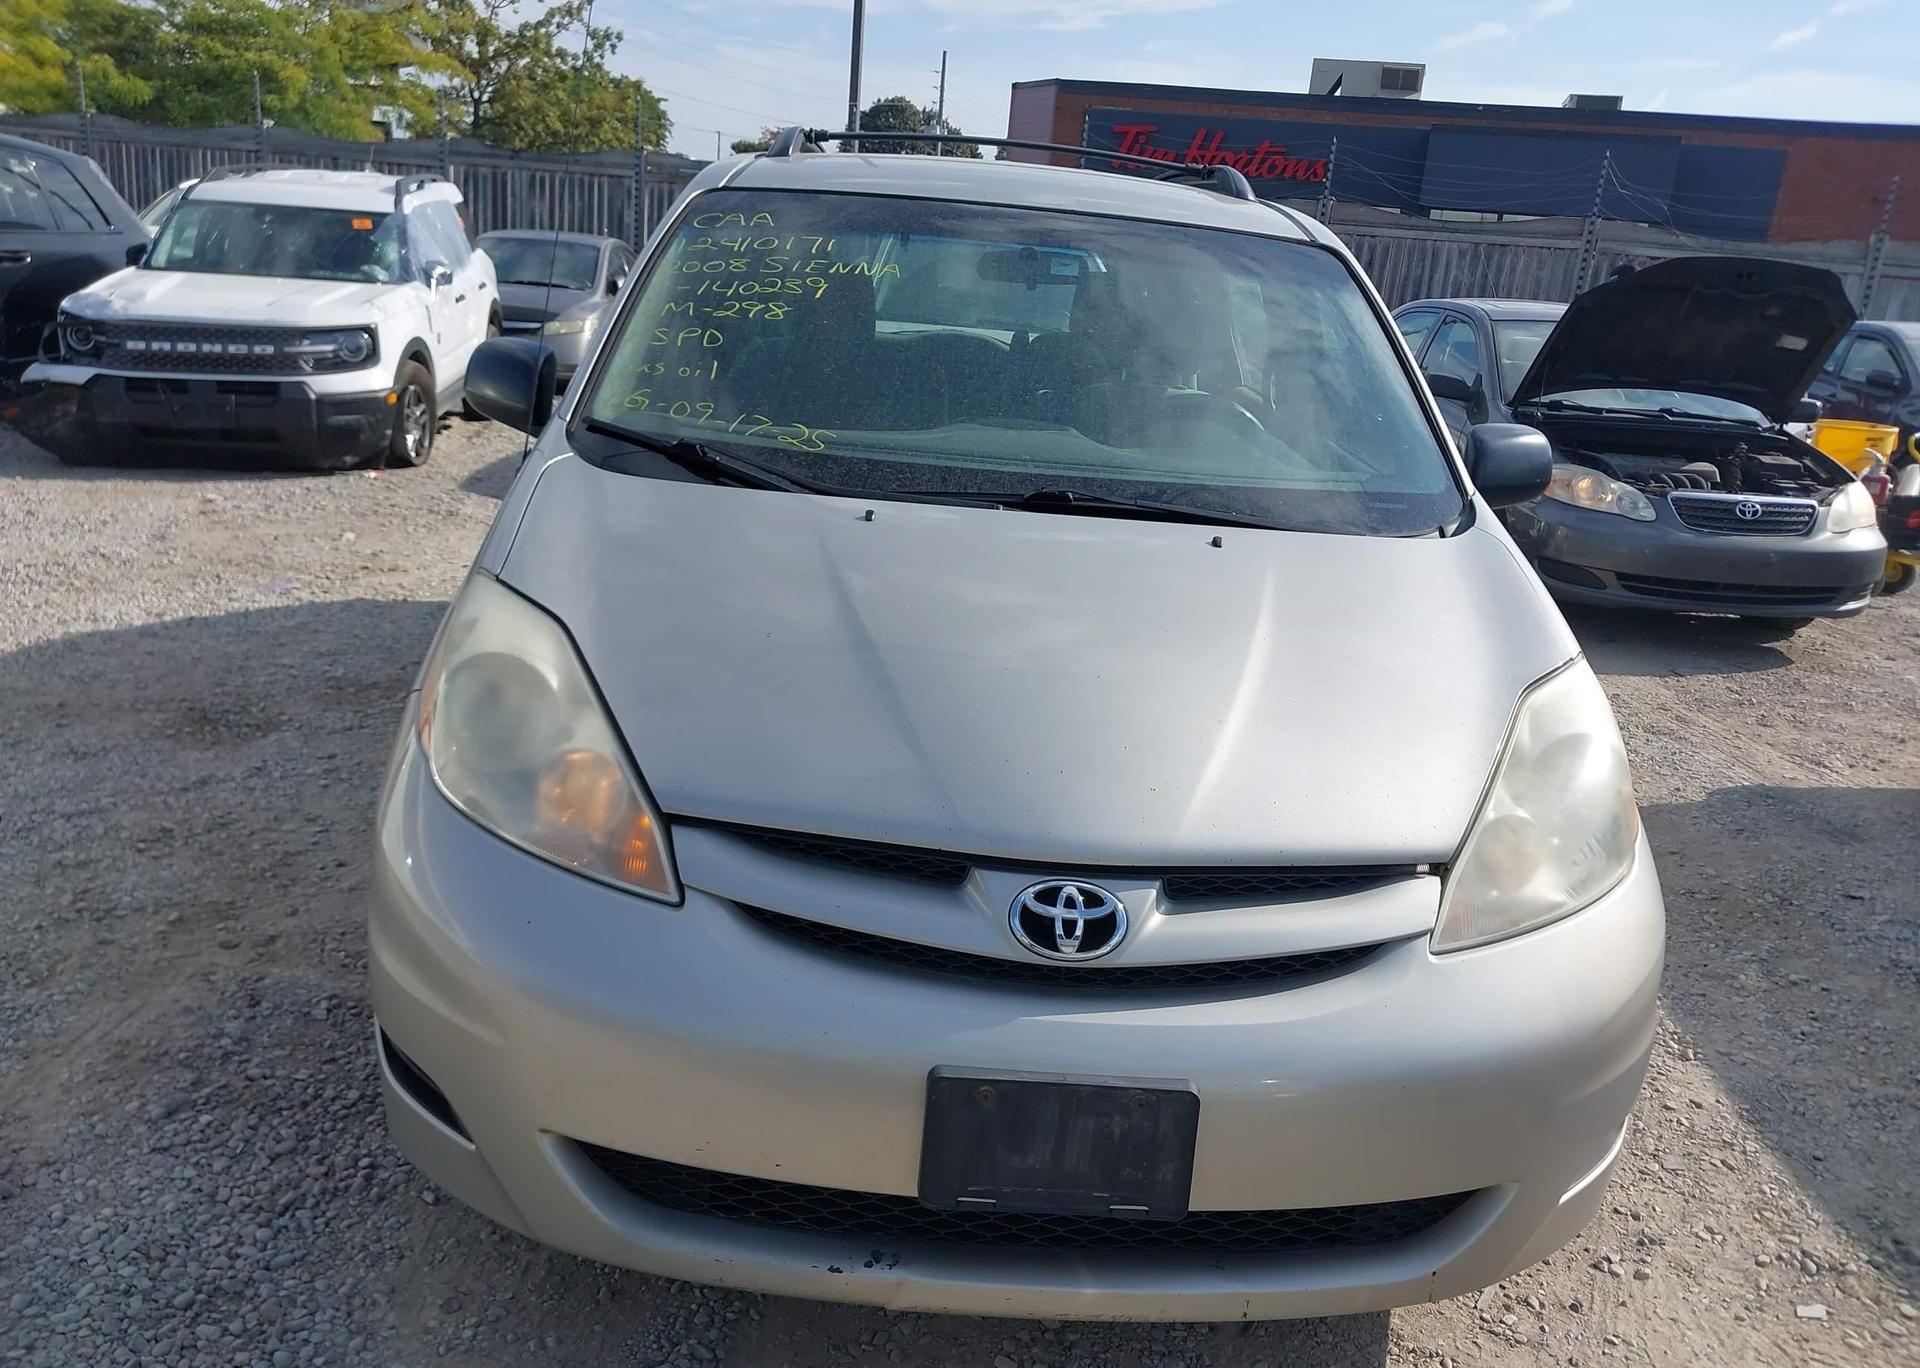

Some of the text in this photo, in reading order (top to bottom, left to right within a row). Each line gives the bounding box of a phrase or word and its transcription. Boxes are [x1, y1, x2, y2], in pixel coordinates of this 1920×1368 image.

[1112, 124, 1328, 183] Tim Hortons
[693, 212, 775, 229] CAA
[671, 256, 901, 280] 2008 SIENNA
[650, 327, 724, 347] SPD
